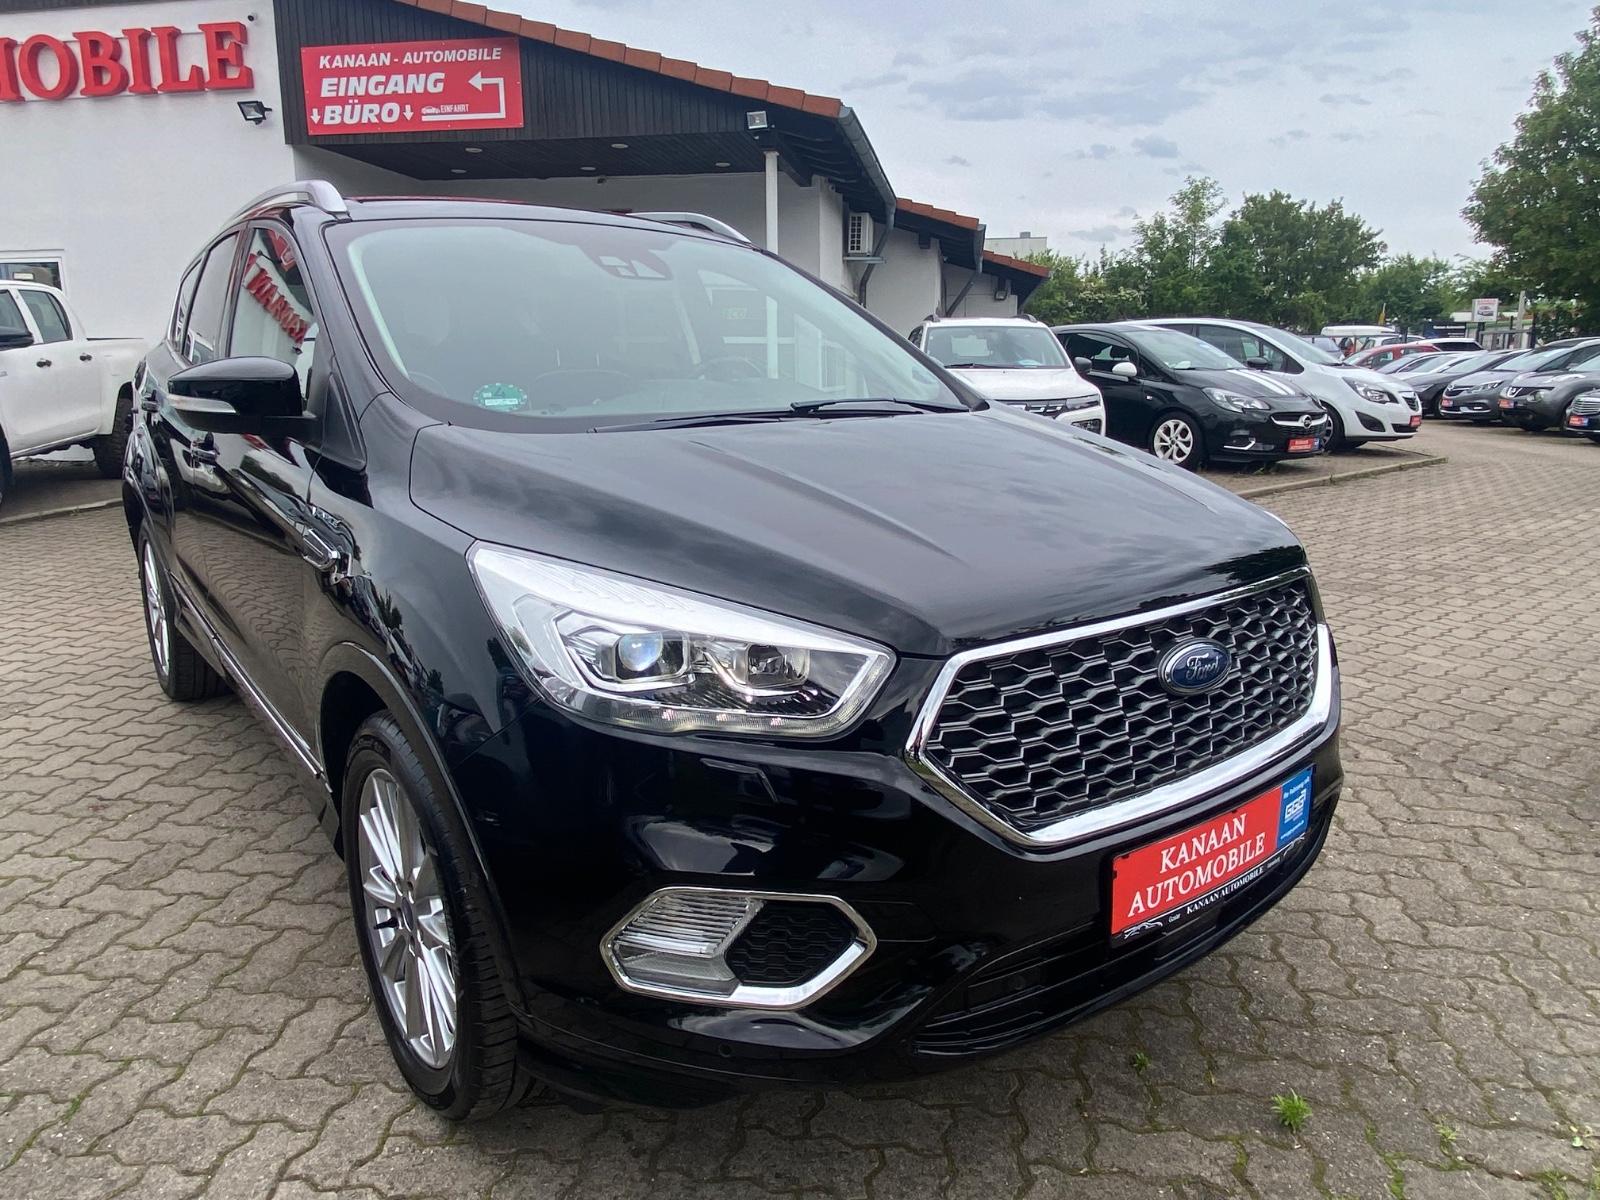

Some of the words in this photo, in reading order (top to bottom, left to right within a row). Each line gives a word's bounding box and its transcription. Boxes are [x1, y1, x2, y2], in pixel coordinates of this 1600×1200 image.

[319, 52, 391, 69] KANAAN
[402, 47, 502, 64] AUTOMOBILE
[320, 72, 446, 98] EINGANG
[322, 99, 400, 125] BÜRO
[440, 103, 469, 113] EINFAHRT
[1186, 652, 1219, 680] Ford
[1159, 813, 1247, 874] KANAAN
[1127, 832, 1266, 918] AUTOMOBILE
[1186, 892, 1220, 914] KANAAN
[1220, 866, 1264, 897] AUTOMOBILE
